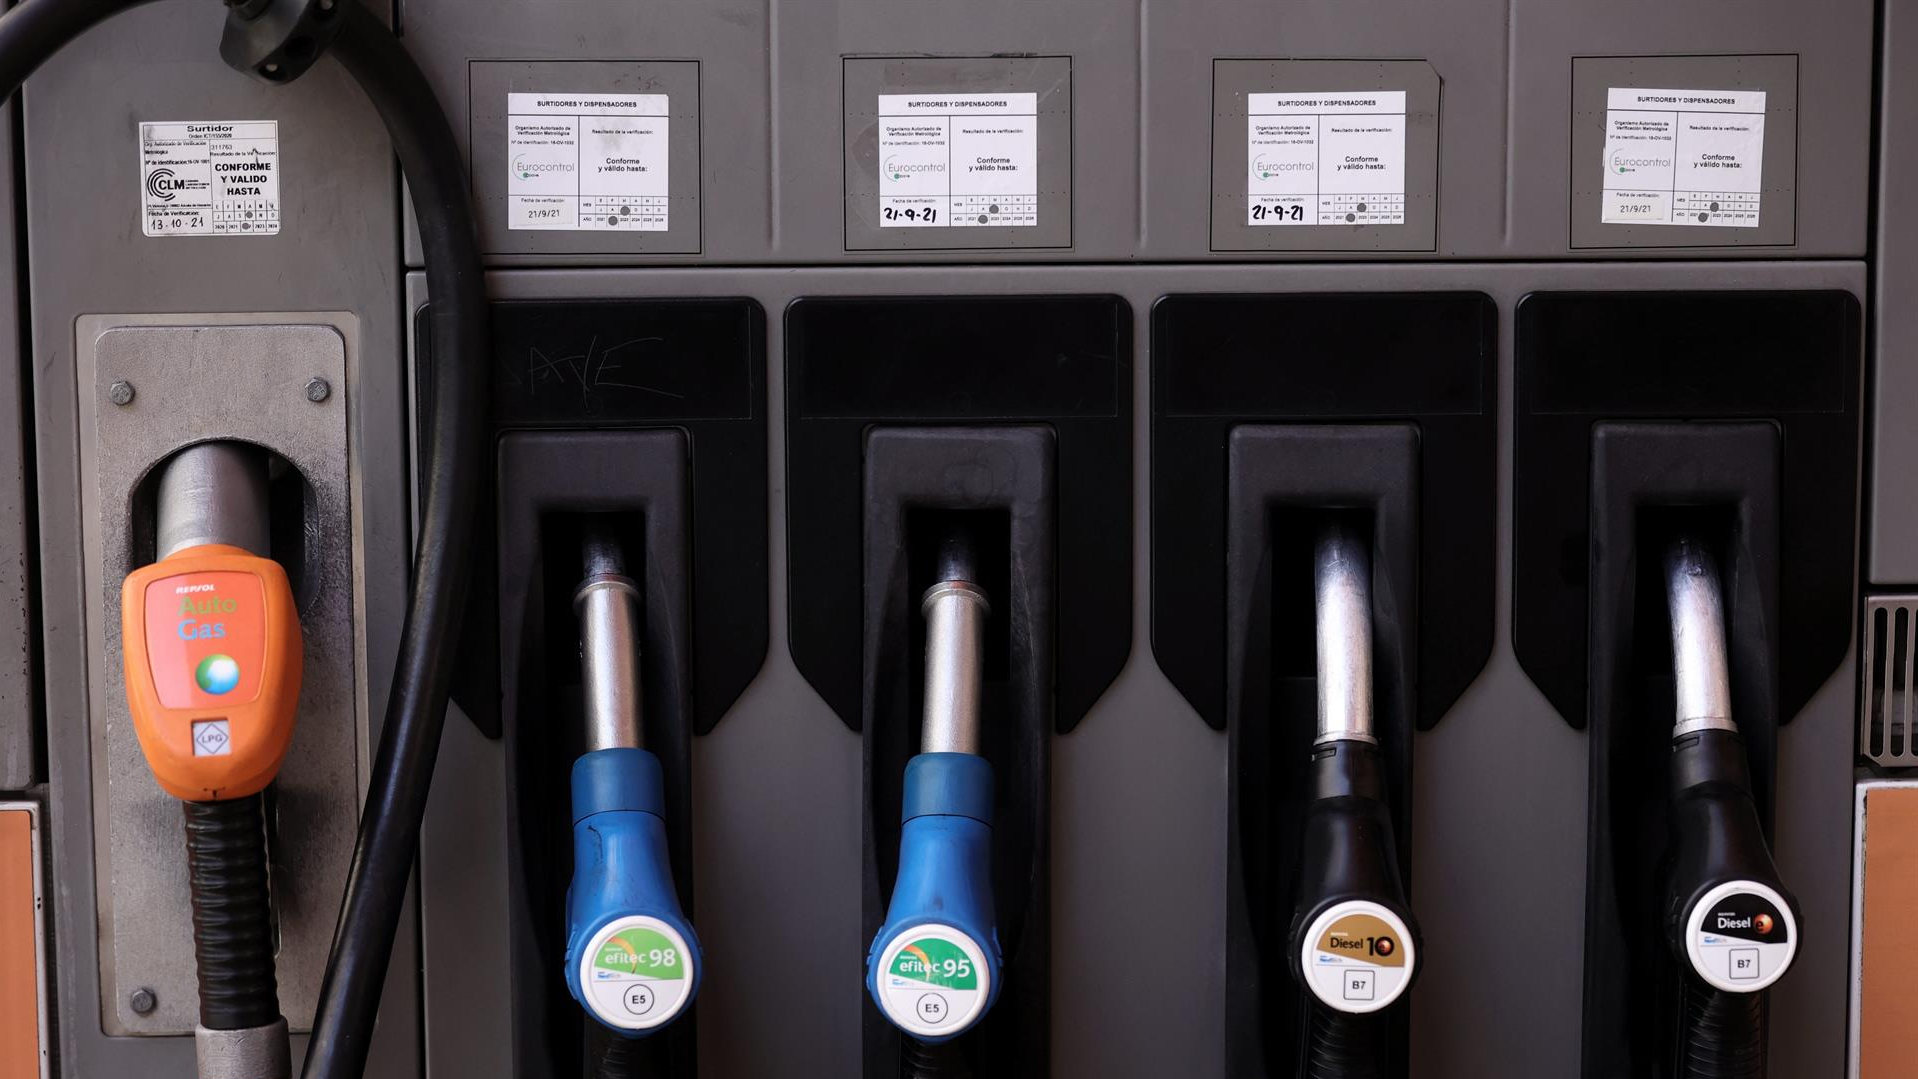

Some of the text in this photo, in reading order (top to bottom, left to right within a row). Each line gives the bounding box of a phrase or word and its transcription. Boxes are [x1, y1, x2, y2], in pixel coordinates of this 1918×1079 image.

[1614, 157, 1671, 167] Eurocontrol
[1701, 153, 1735, 161] Conforme
[215, 163, 271, 171] CONFORME
[517, 162, 575, 172] Eurocontrol
[888, 163, 945, 173] Eurocontrol
[1257, 162, 1314, 171] Eurocontrol
[230, 175, 267, 183] VALIDO
[158, 180, 185, 190] CLM
[528, 209, 560, 219] 21/9/21
[1252, 205, 1304, 221] 21-9-21
[1620, 205, 1651, 213] 21/9/21
[883, 207, 937, 223] 21-9-21
[175, 584, 215, 594] REPSOL
[177, 596, 238, 616] Auto
[177, 618, 226, 641] Gas
[201, 734, 223, 743] LPG
[1718, 917, 1751, 929] Diesel
[1330, 936, 1394, 957] Diesel 10
[605, 948, 676, 968] efitec 98
[900, 958, 970, 978] efitec 95
[1737, 960, 1751, 968] B7
[1352, 981, 1366, 990] B7
[632, 995, 646, 1005] E5
[925, 1004, 939, 1013] E5
